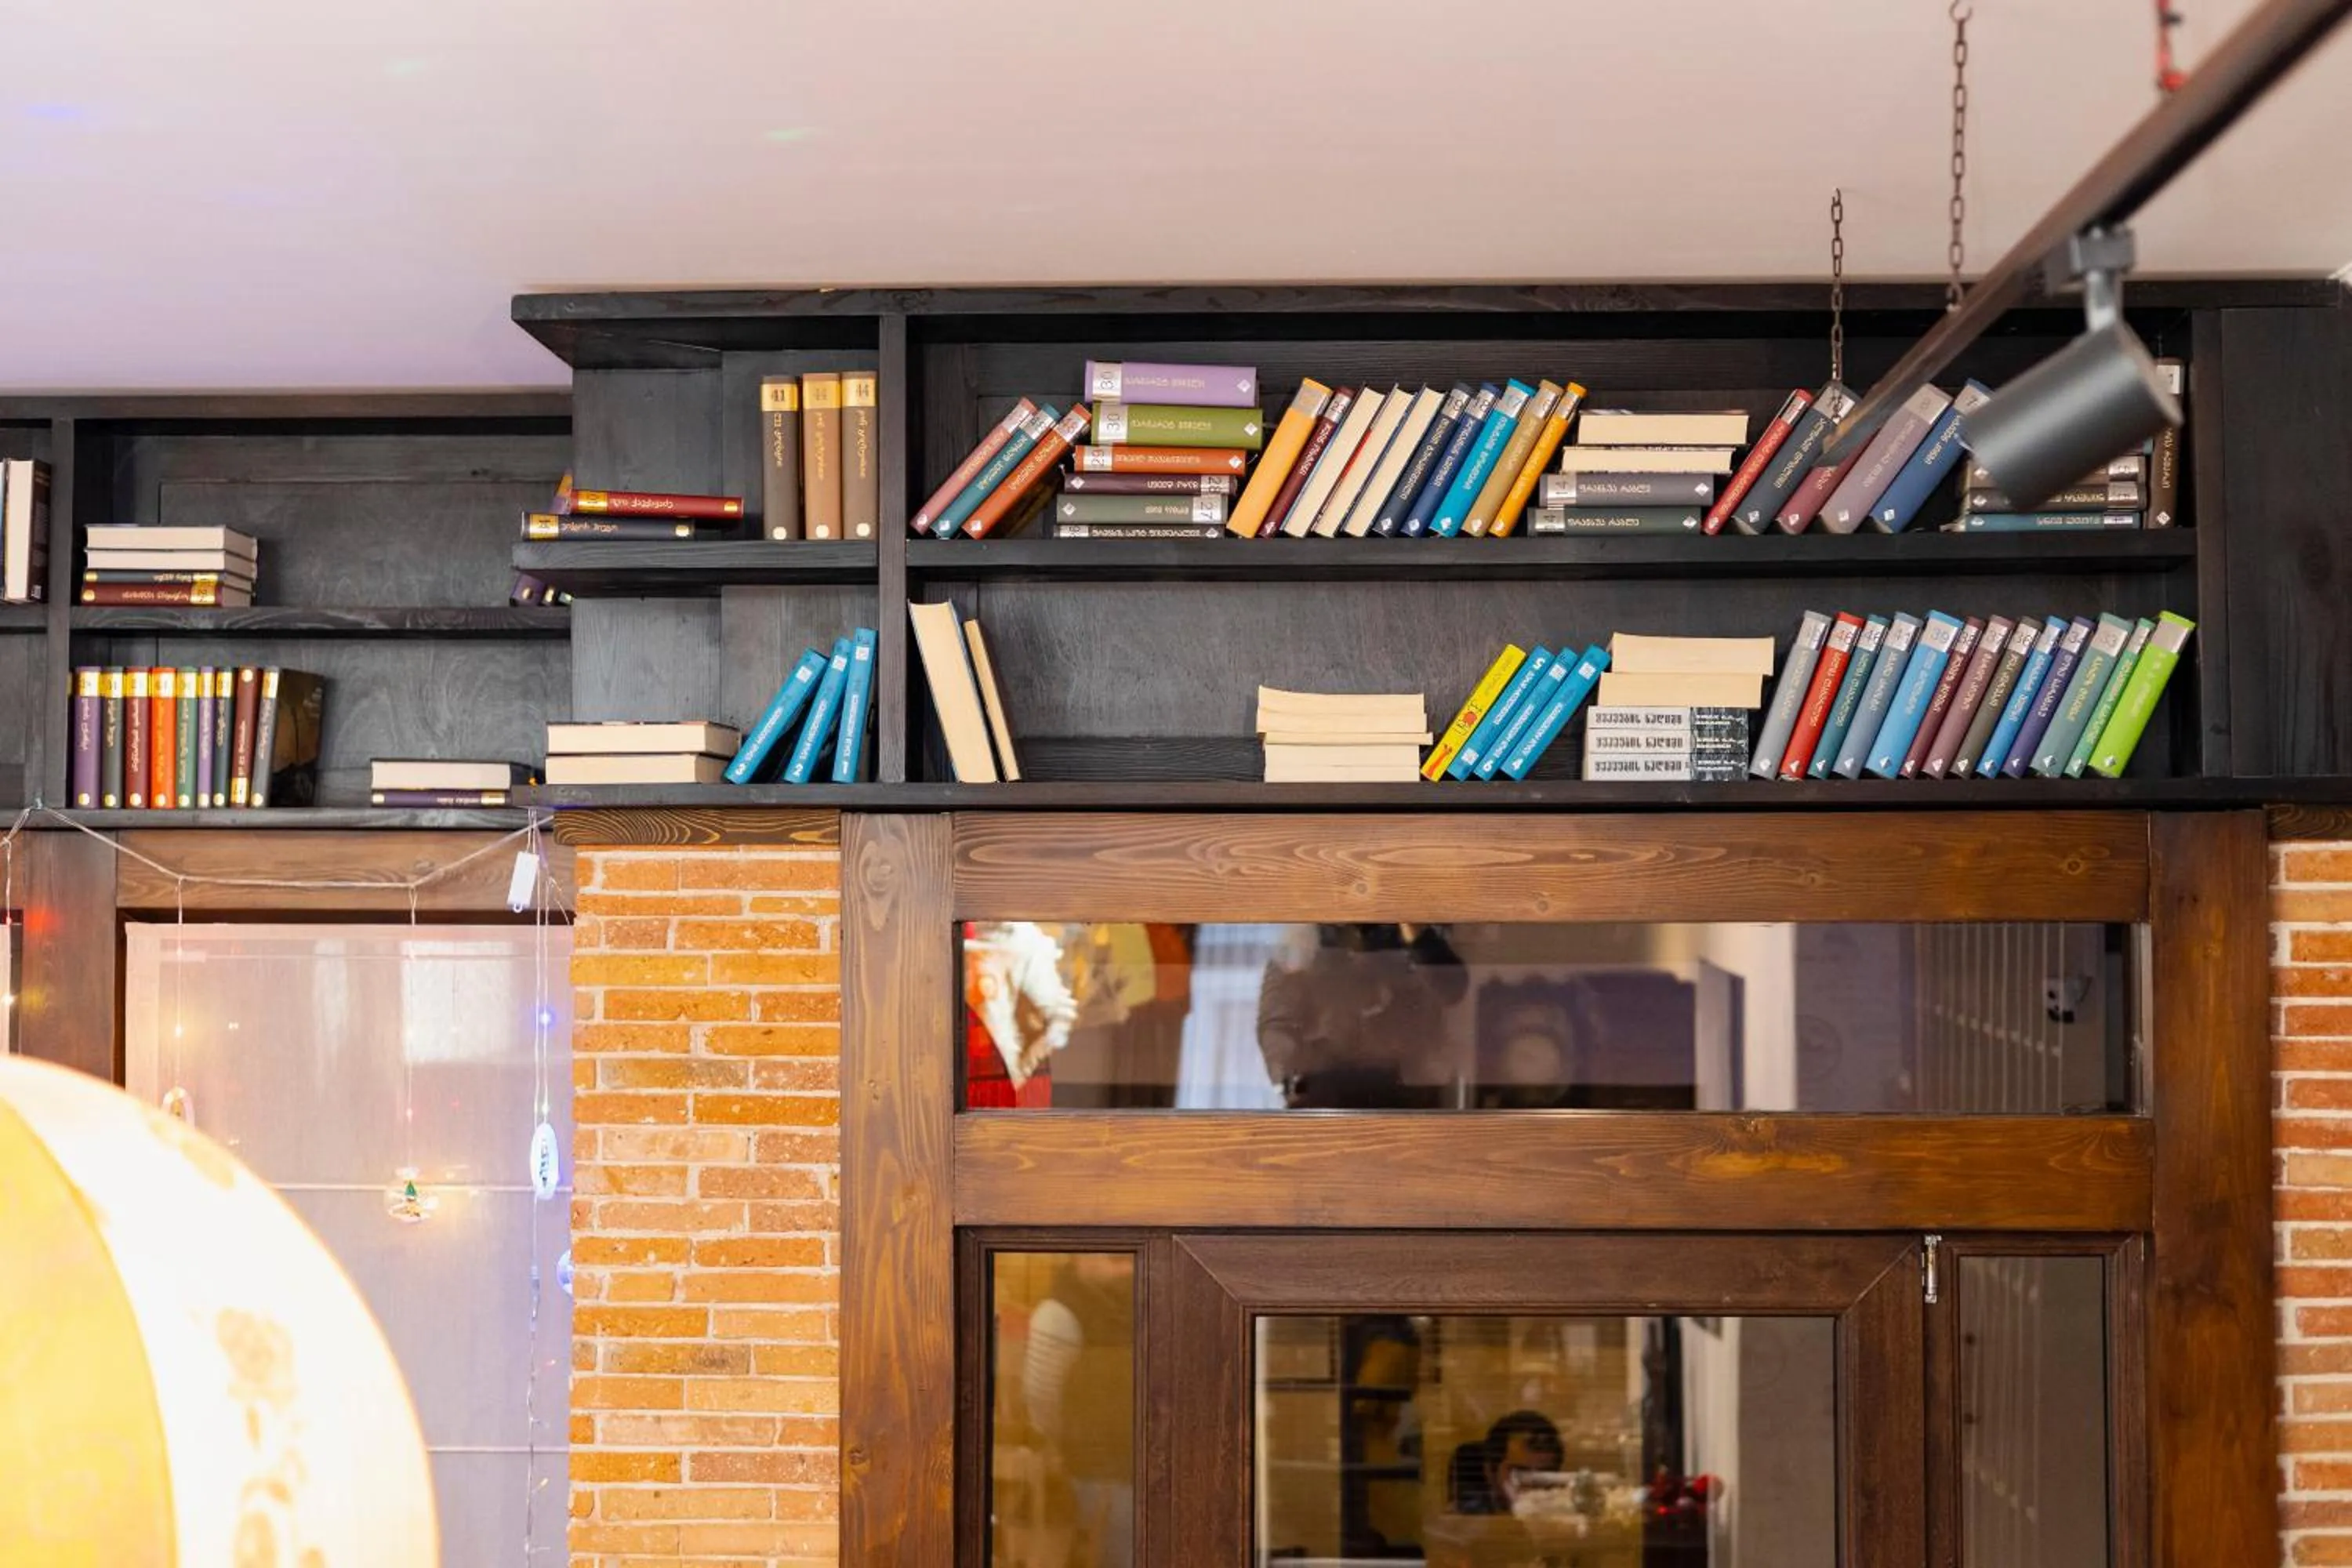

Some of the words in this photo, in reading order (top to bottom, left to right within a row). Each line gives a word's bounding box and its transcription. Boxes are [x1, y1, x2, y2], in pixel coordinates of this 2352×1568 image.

[1100, 370, 1115, 390] 30
[1105, 413, 1121, 431] 30
[1090, 450, 1104, 466] 29
[1146, 480, 1174, 488] ტვენი
[1176, 480, 1198, 488] მარკ
[1208, 476, 1221, 493] 28
[1554, 481, 1569, 495] 14
[1200, 501, 1214, 519] 27
[1532, 655, 1546, 671] 5
[733, 760, 748, 777] 3
[792, 762, 804, 777] 2
[840, 760, 849, 775] 1
[1481, 757, 1495, 772] 6
[1510, 755, 1524, 771] 4
